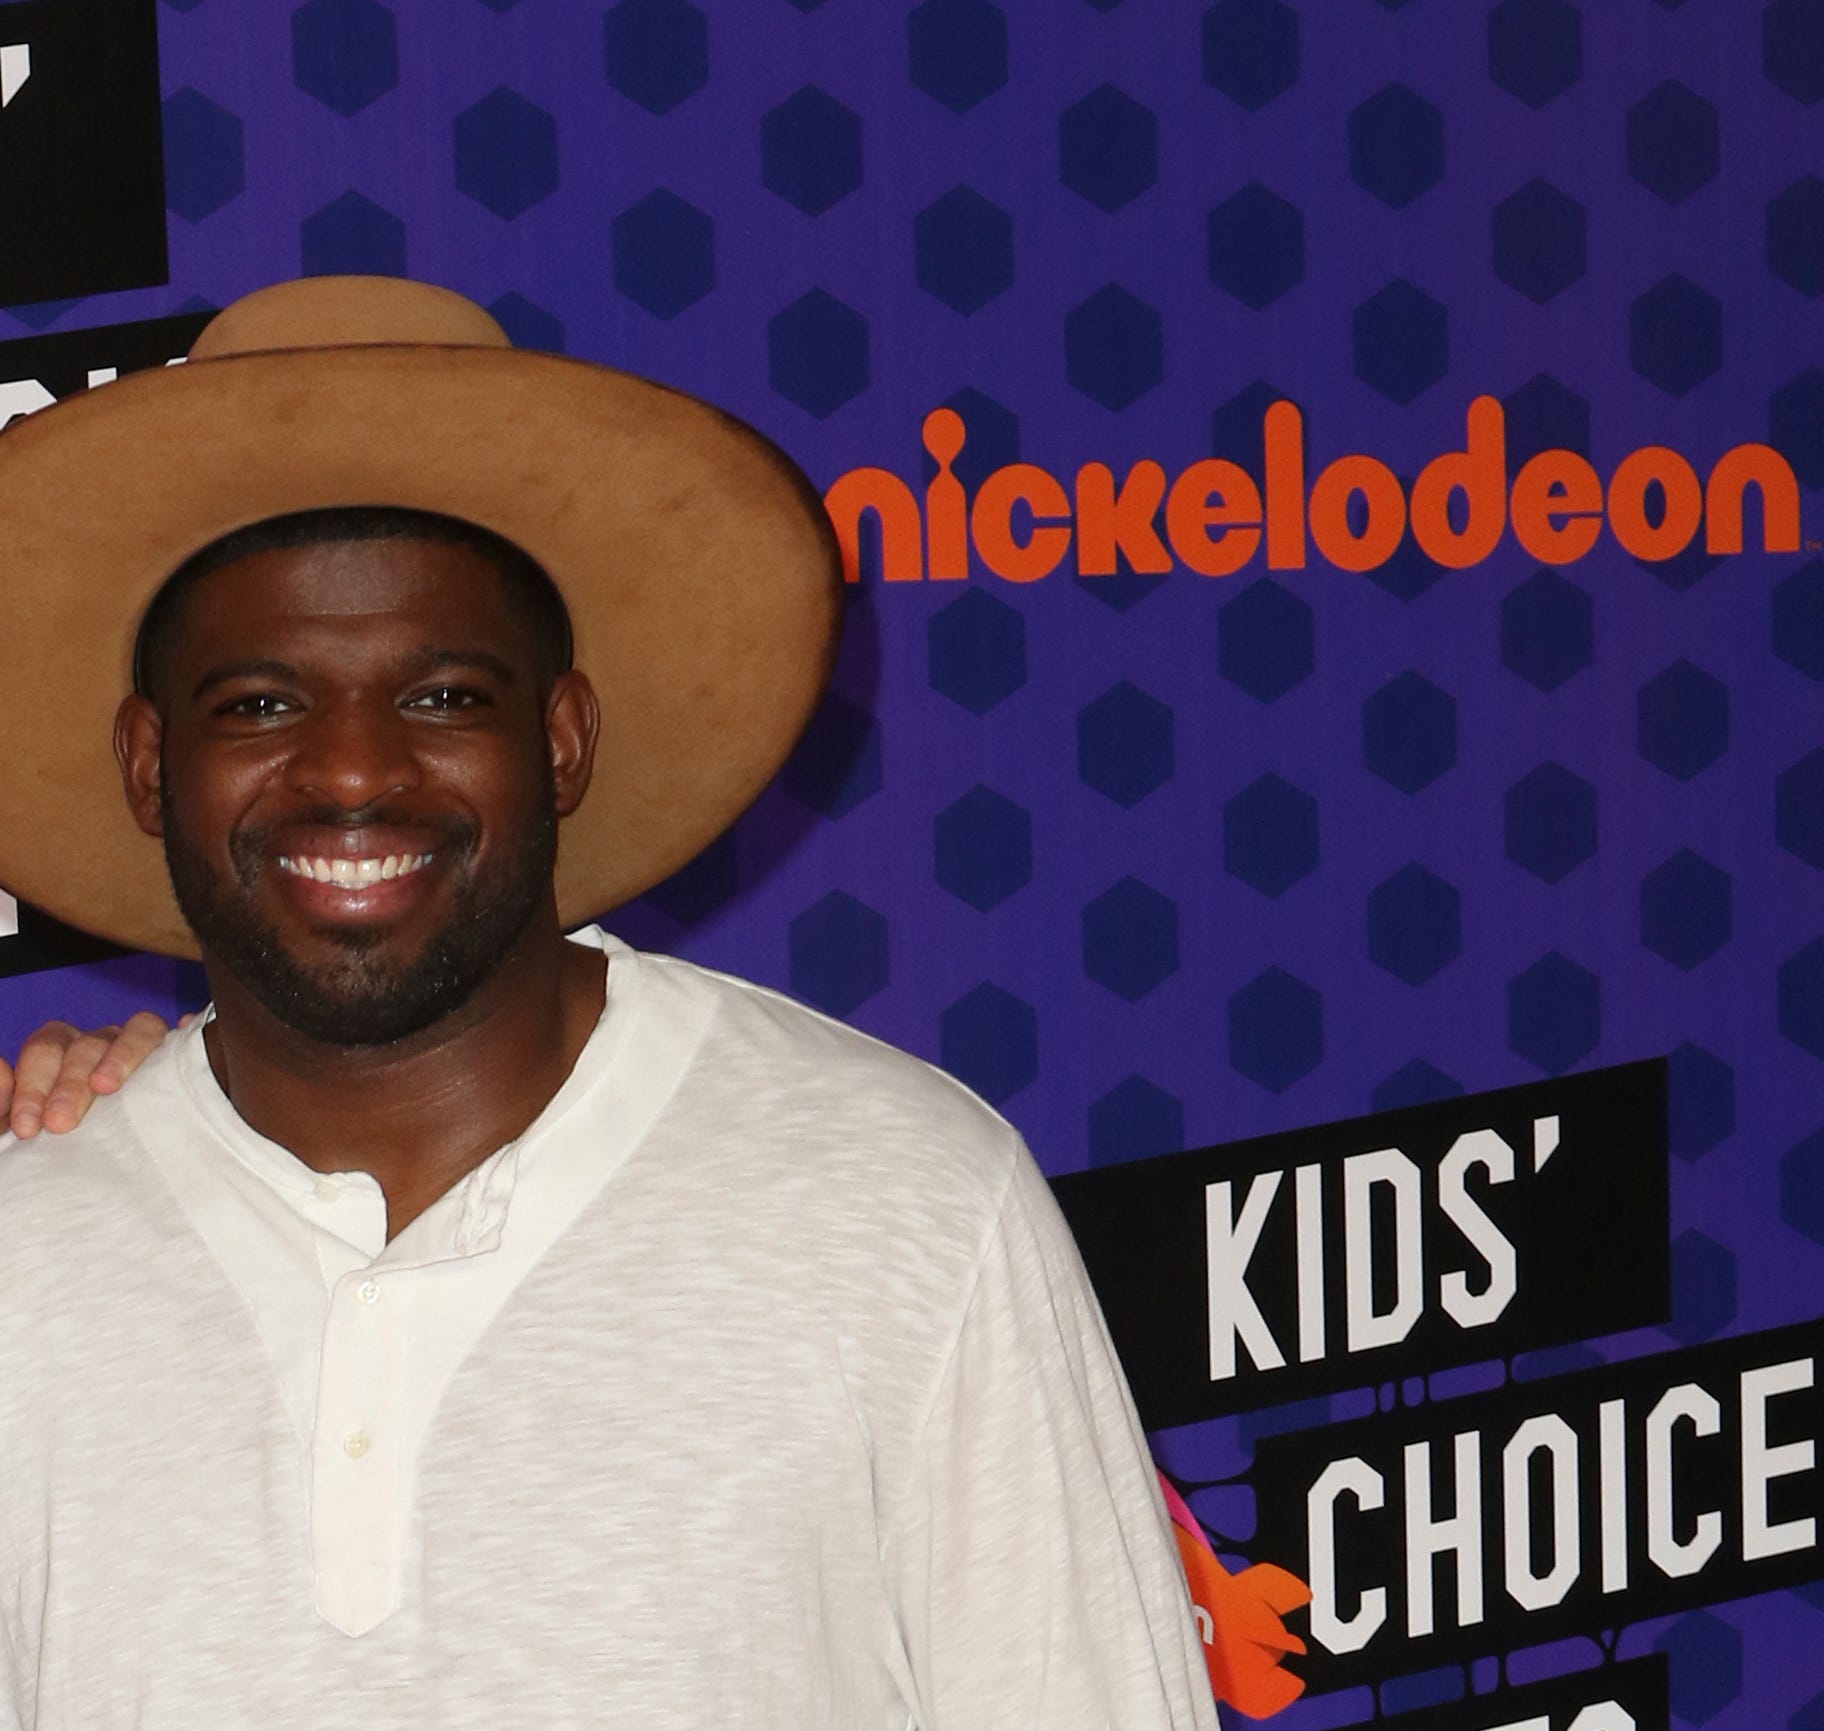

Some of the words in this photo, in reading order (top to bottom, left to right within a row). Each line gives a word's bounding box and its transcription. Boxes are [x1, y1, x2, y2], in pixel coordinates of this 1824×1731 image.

[823, 394, 1801, 584] nickelodeon
[1204, 1114, 1561, 1382] KIDS'
[1307, 1356, 1817, 1656] CHOICE
